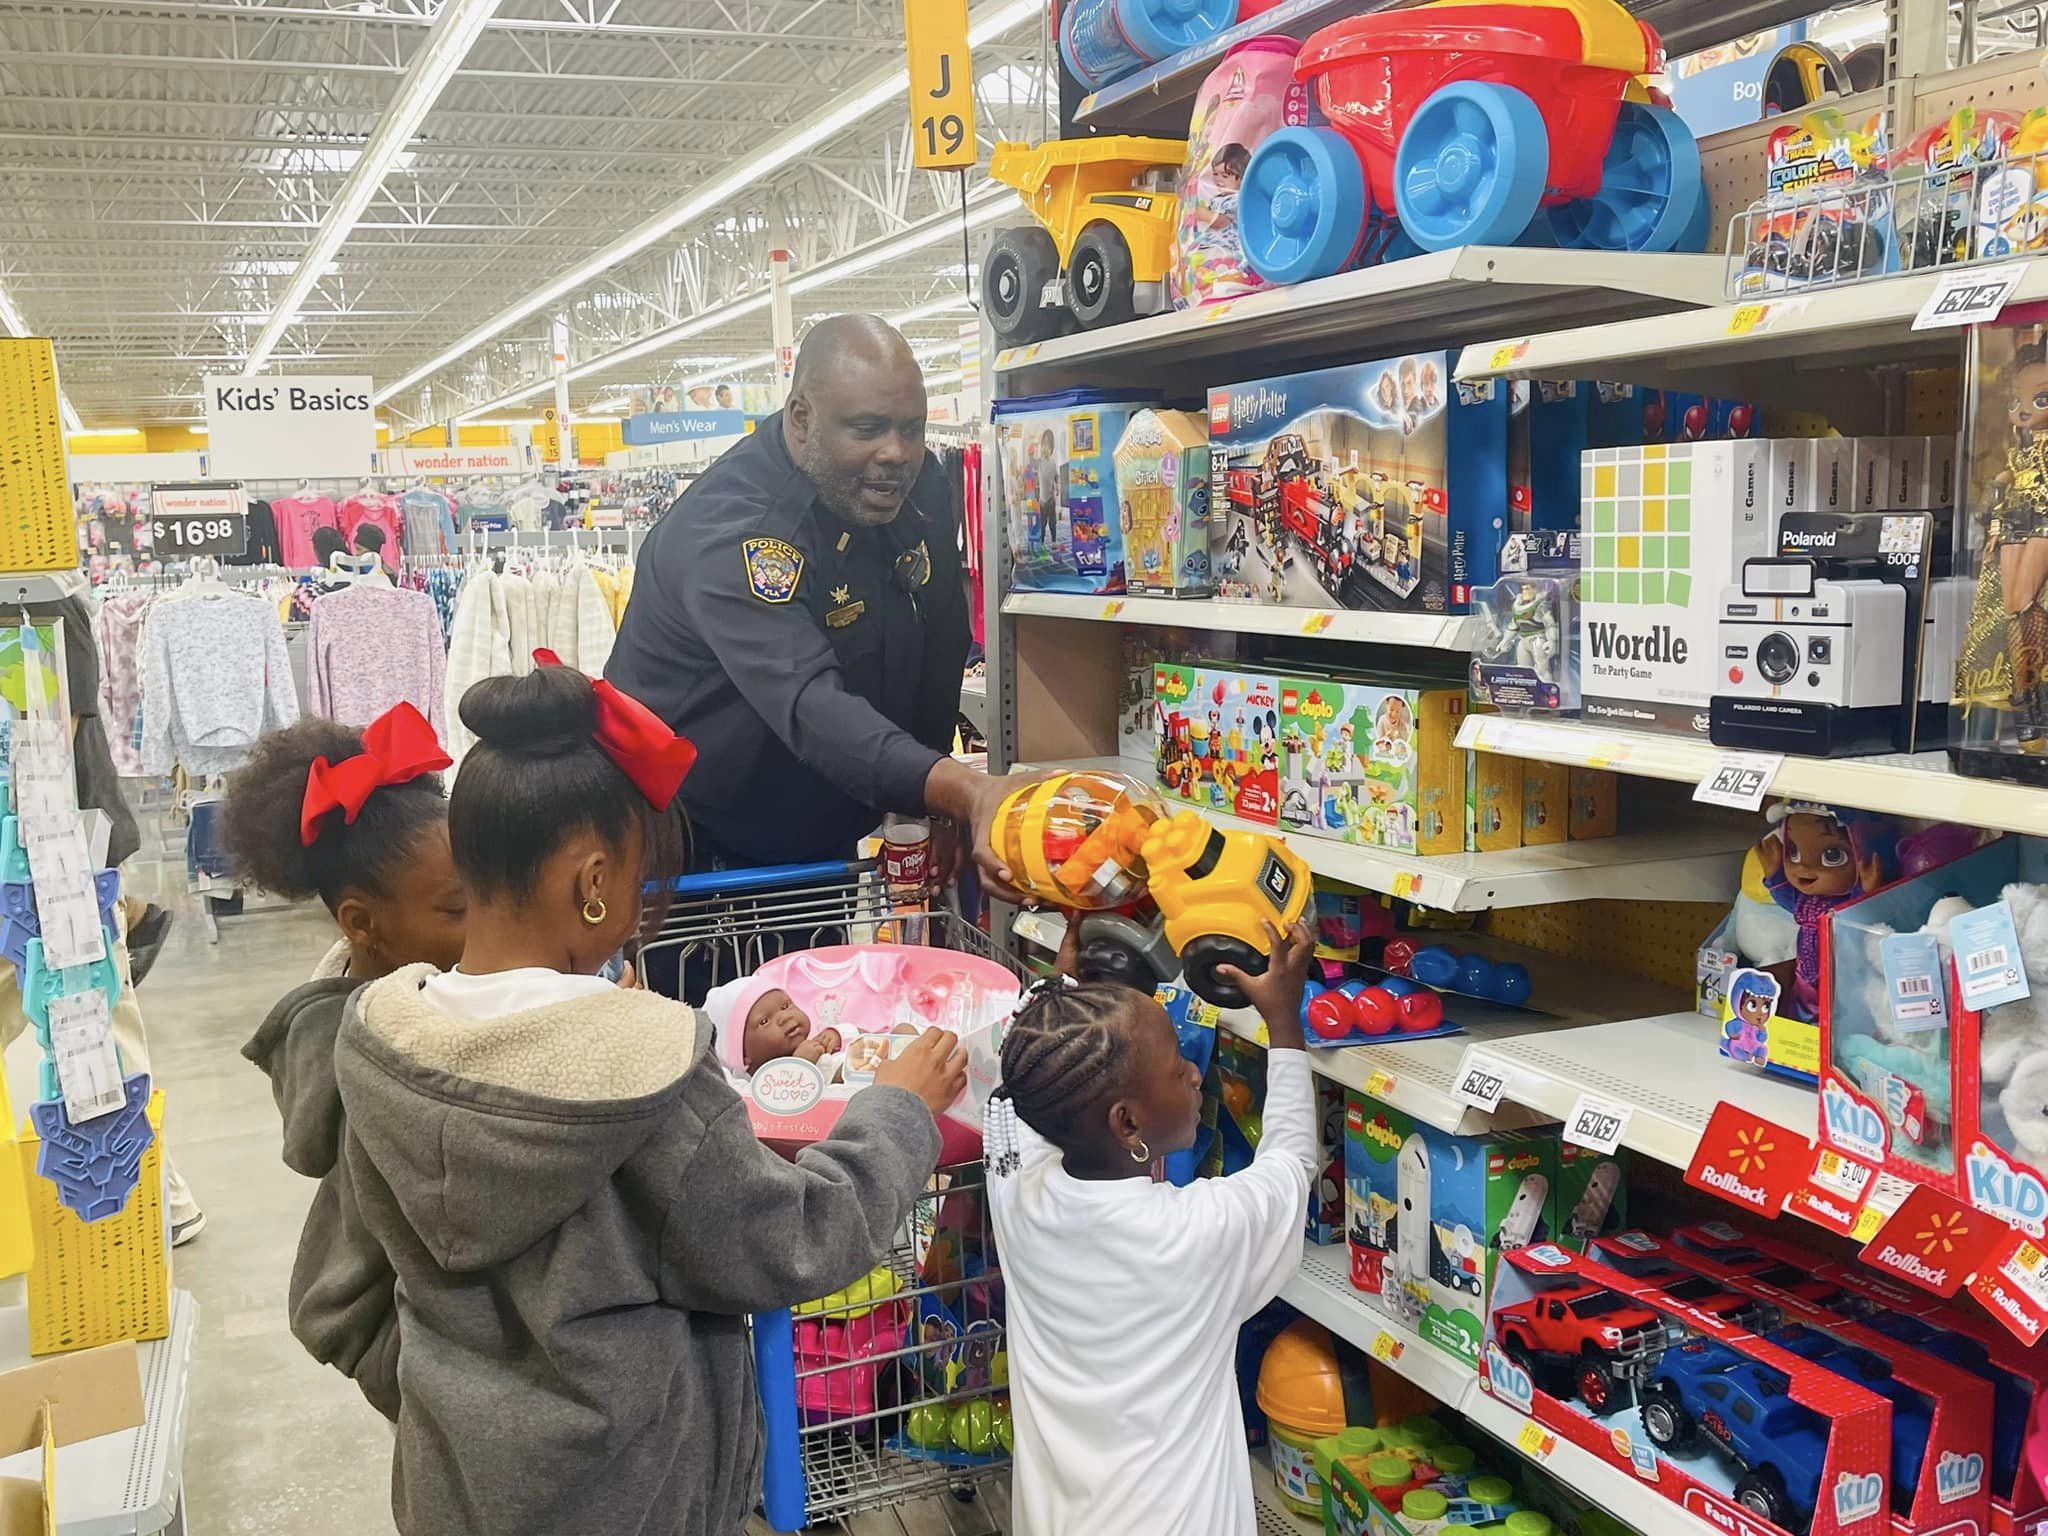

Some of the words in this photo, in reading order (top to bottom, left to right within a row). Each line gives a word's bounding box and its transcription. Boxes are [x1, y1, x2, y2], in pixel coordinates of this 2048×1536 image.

[929, 55, 949, 98] J
[921, 114, 965, 156] 19
[1772, 162, 1819, 187] COLOR
[1135, 197, 1151, 210] CAT
[216, 387, 279, 411] Kids'
[290, 388, 370, 411] Basics
[1211, 406, 1229, 422] LEGO
[1232, 394, 1260, 429] Harry
[1260, 386, 1287, 419] Potter
[650, 420, 680, 434] Men's
[683, 419, 718, 432] Wear
[550, 437, 556, 446] E
[550, 449, 559, 457] 15
[414, 452, 463, 469] wonder
[1745, 463, 1754, 508] Games
[1786, 461, 1795, 506] Games
[1829, 461, 1838, 506] Games
[1452, 530, 1465, 557] Potter
[1782, 531, 1837, 547] Polaroid
[749, 540, 799, 563] POLICE
[1887, 552, 1911, 566] 500
[1588, 621, 1689, 665] Wordle
[1592, 663, 1607, 675] The
[1608, 665, 1629, 679] Party
[1630, 667, 1653, 679] Game
[1166, 681, 1187, 697] duplo
[1246, 694, 1275, 708] MICKEY
[1300, 699, 1333, 720] duplo
[1733, 703, 1761, 712] POLAROID
[1762, 704, 1777, 713] LAND
[1778, 706, 1802, 714] CAMERA
[1262, 791, 1277, 813] 2+
[760, 1072, 816, 1096] Sweet
[776, 1121, 798, 1131] First
[800, 1122, 820, 1135] Day
[1347, 1109, 1363, 1121] LEGO
[1366, 1119, 1402, 1150] duplo
[1825, 1093, 1882, 1145] KID
[1508, 1155, 1540, 1171] duplo
[1842, 1160, 1867, 1184] 5.00
[1700, 1165, 1769, 1207] Rollback
[1970, 1159, 2045, 1219] KID
[1807, 1194, 1852, 1226] Rollback
[1534, 1246, 1568, 1265] KID
[2020, 1246, 2040, 1265] 5.00
[1878, 1246, 1948, 1290] Rollback
[1991, 1287, 2040, 1336] Rollback
[1460, 1328, 1480, 1356] 2+
[1489, 1354, 1531, 1400] KID
[1937, 1455, 1982, 1493] KID
[1837, 1476, 1880, 1514] KID
[1704, 1501, 1735, 1531] Fast
